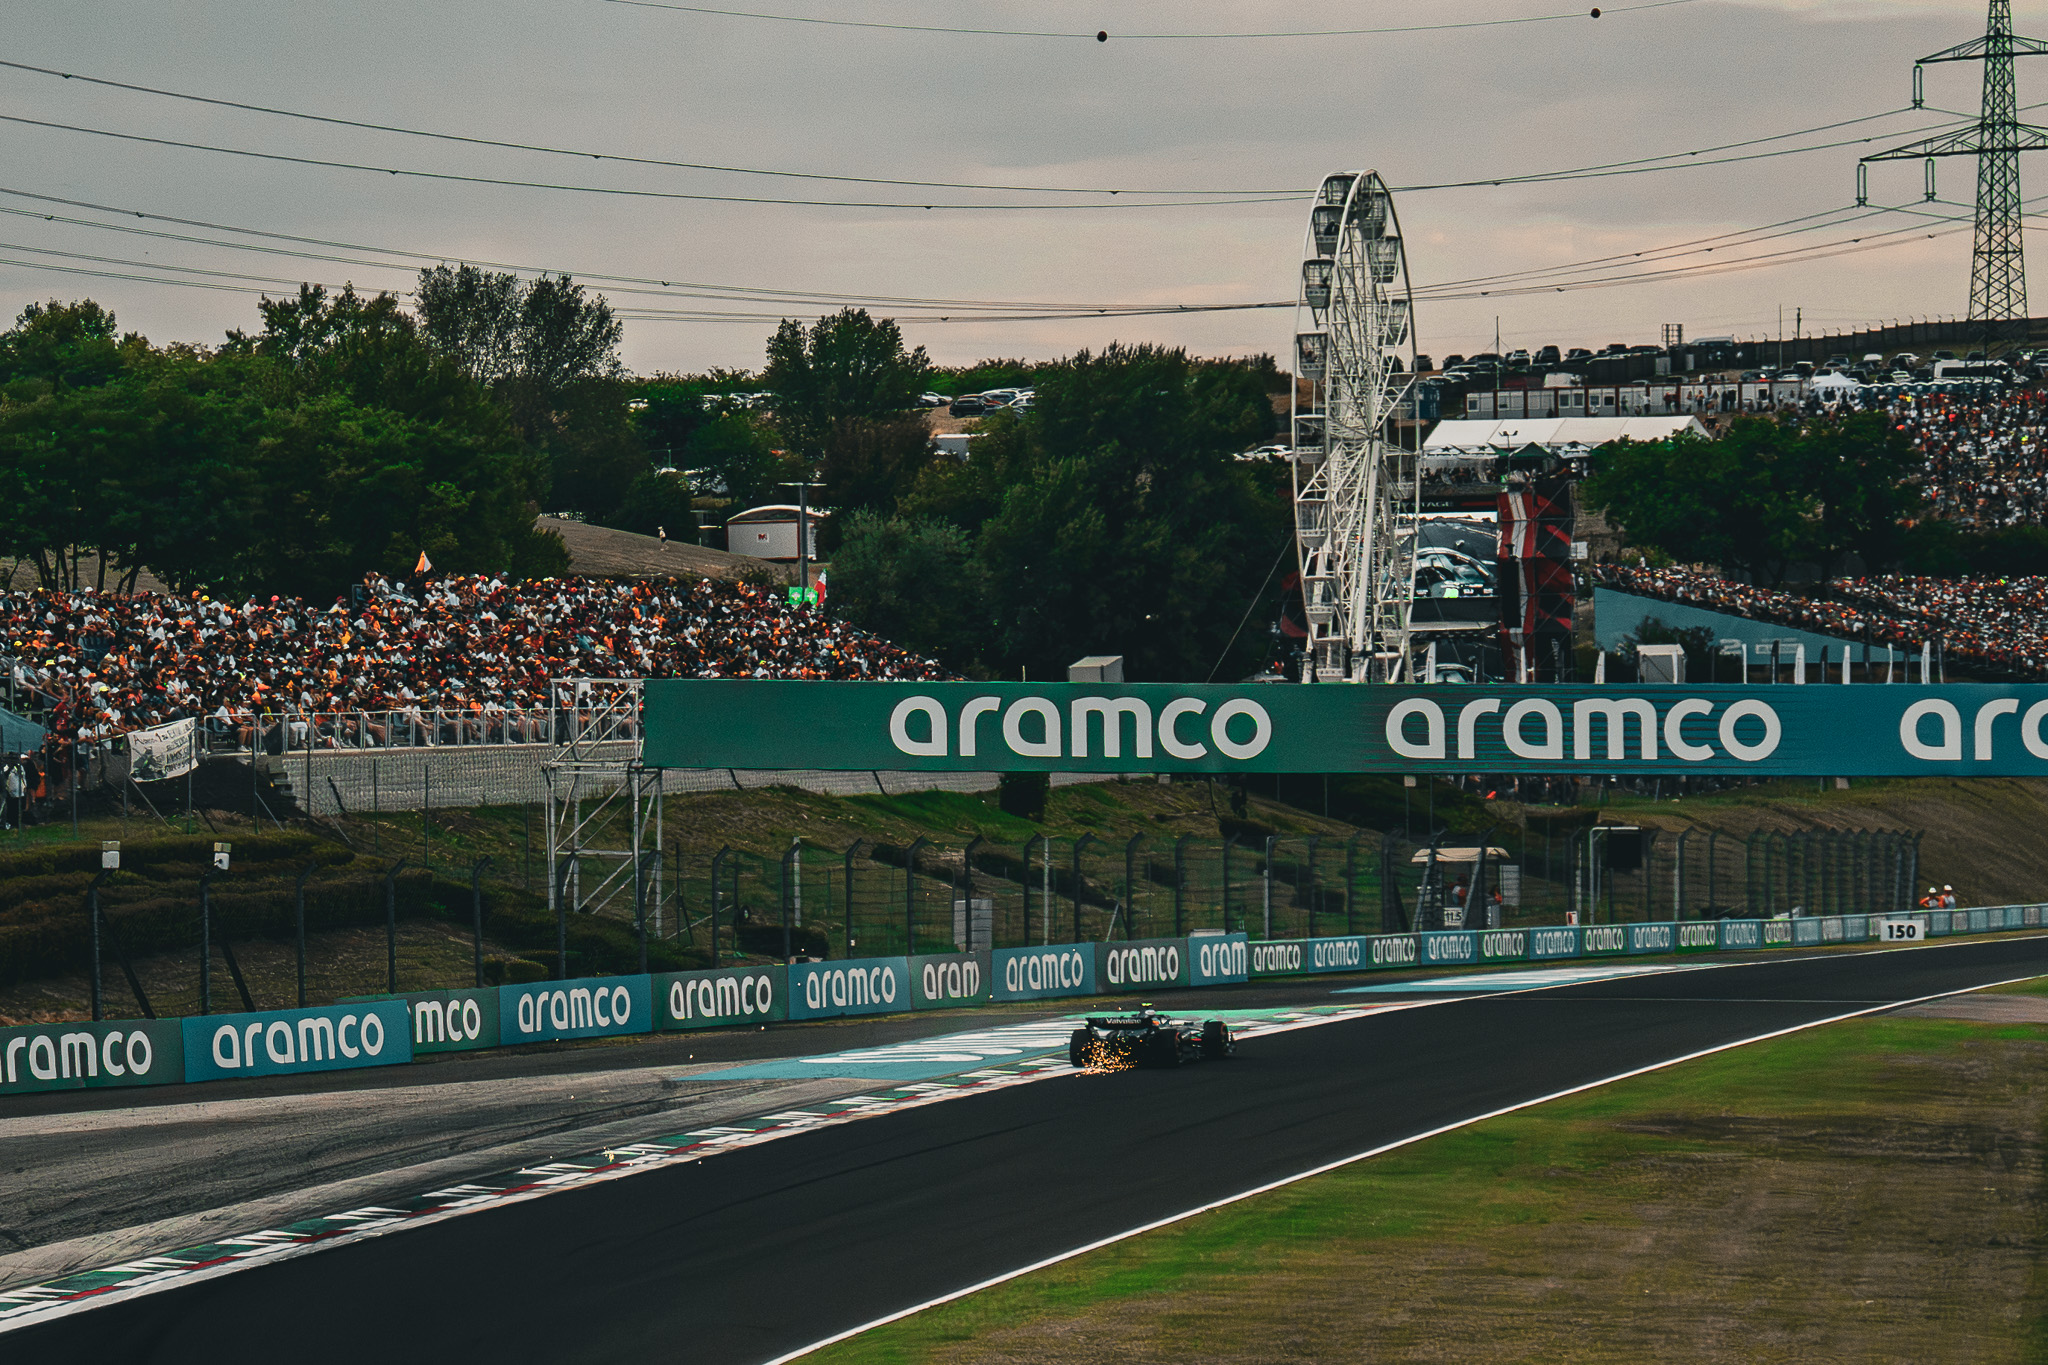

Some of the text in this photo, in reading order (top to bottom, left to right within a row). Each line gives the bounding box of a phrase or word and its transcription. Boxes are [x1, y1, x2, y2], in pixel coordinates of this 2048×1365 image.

[889, 695, 1272, 759] aramco
[1385, 698, 1782, 761] aramco
[1428, 935, 1472, 960] aramco
[1483, 932, 1524, 957] aramco
[1535, 931, 1575, 954] aramco
[1585, 928, 1624, 951] aramco
[1634, 926, 1670, 948] aramco
[1679, 924, 1716, 946] aramco
[1888, 924, 1916, 939] 150
[1107, 946, 1179, 984] aramco
[1201, 941, 1247, 976] aram
[1253, 944, 1301, 972] aramco
[1314, 940, 1360, 968] aramco
[1372, 937, 1415, 963] aramco
[806, 965, 896, 1009] aramco
[1006, 952, 1083, 992] aramco
[518, 986, 631, 1032] aramco
[670, 974, 771, 1019] aramco
[407, 999, 480, 1043] mco
[0, 1031, 152, 1083] ramco
[212, 1013, 385, 1068] aramco
